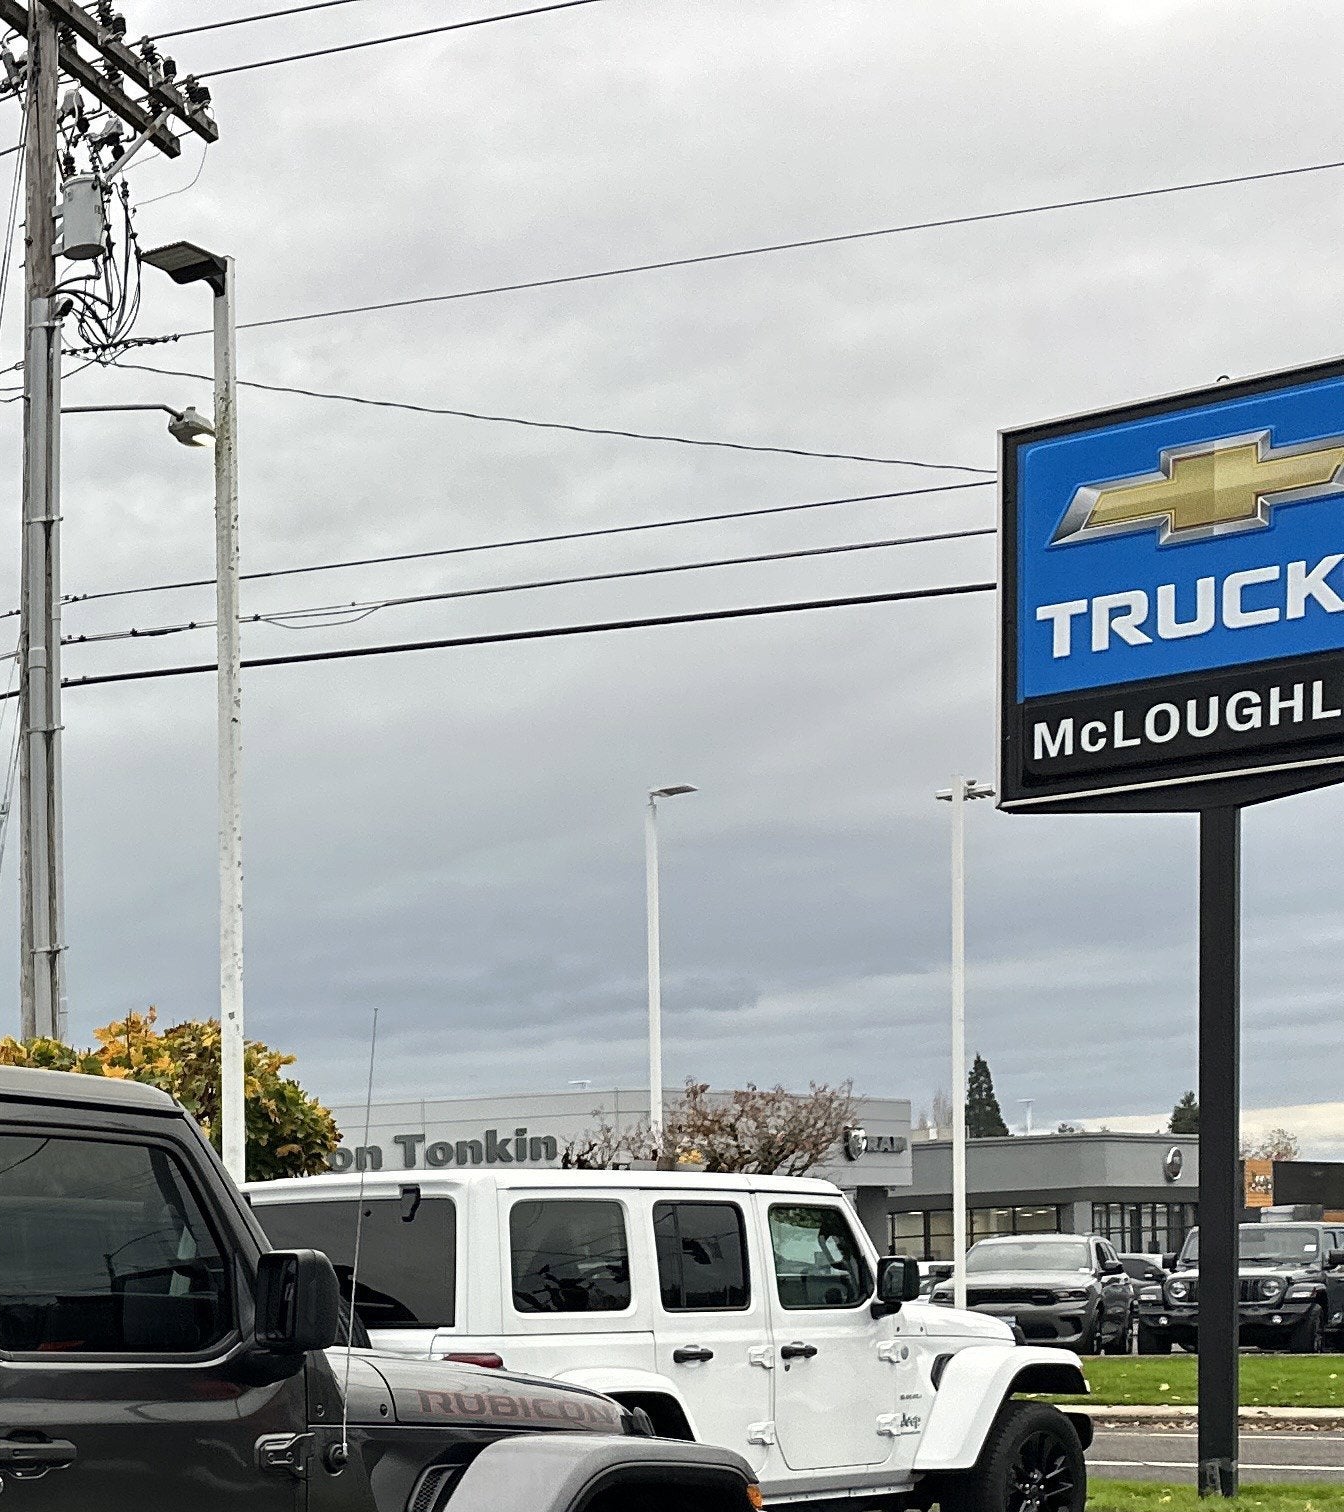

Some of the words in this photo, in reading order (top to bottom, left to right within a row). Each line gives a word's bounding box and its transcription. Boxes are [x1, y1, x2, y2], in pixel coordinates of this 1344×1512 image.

[1036, 553, 1344, 659] TRUCK
[1032, 679, 1342, 760] McLOUGHL
[326, 1145, 383, 1172] on
[394, 1127, 559, 1170] Tonkin
[417, 1389, 621, 1425] RUBICON
